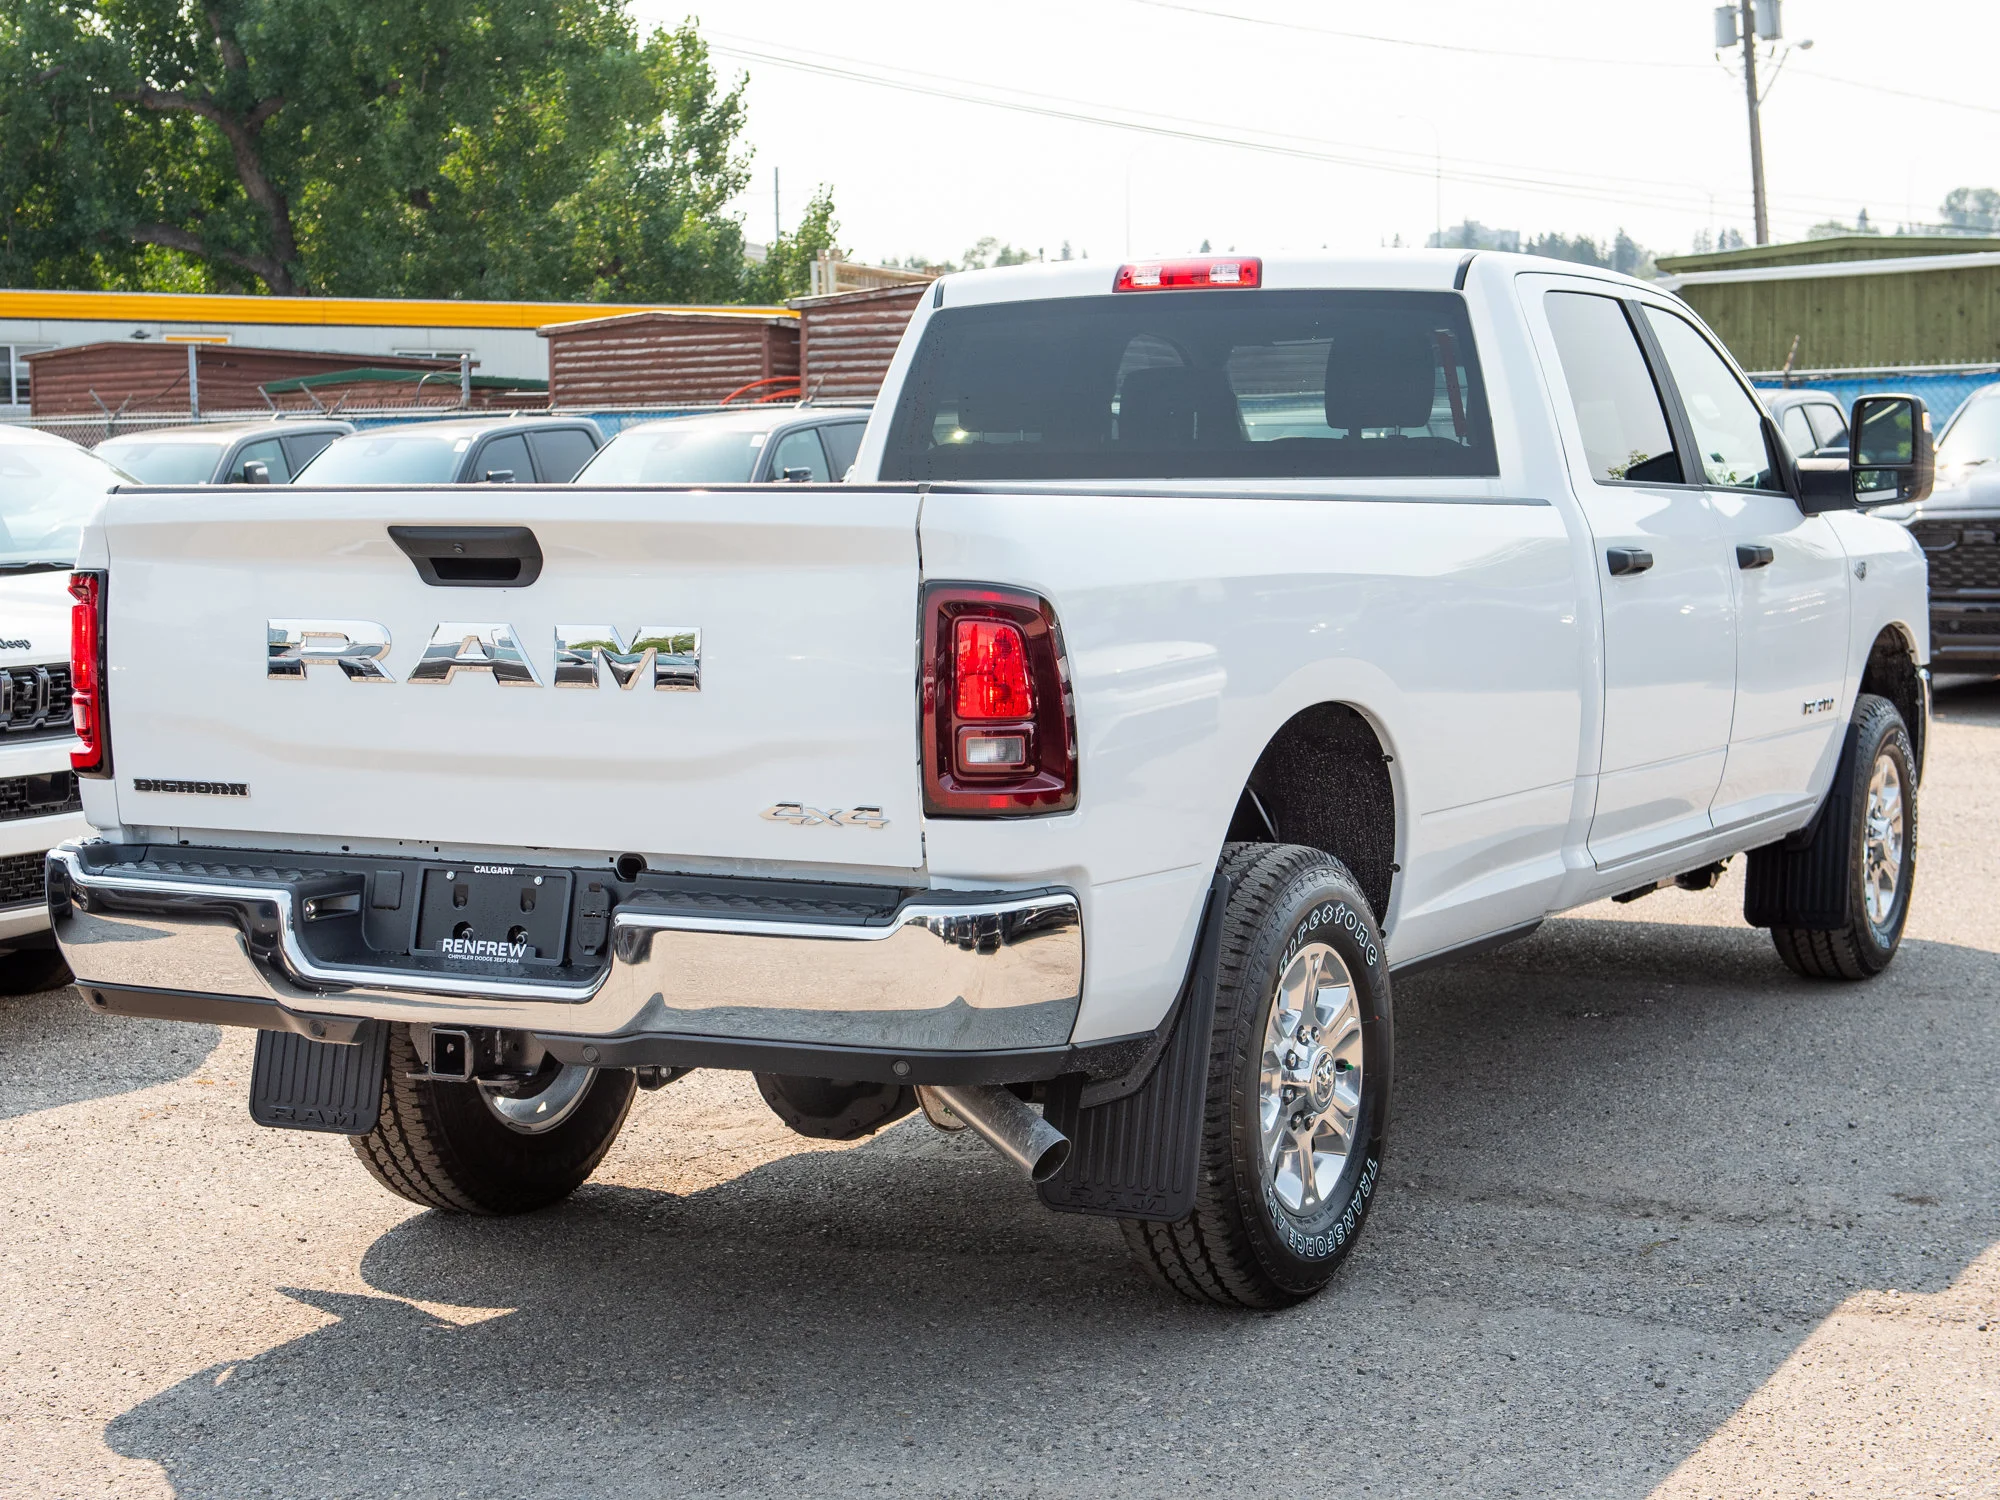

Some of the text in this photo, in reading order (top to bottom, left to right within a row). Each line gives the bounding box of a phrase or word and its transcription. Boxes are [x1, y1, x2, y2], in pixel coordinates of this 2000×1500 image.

[267, 617, 702, 692] RAM
[133, 778, 251, 798] BIGHORN
[473, 865, 515, 875] CALGARY
[442, 938, 527, 958] RENFREW
[1279, 902, 1378, 977] Firestone
[447, 953, 474, 961] CHRYSLER
[267, 1104, 358, 1127] RAM
[1287, 1158, 1379, 1257] TRANSFORCE
